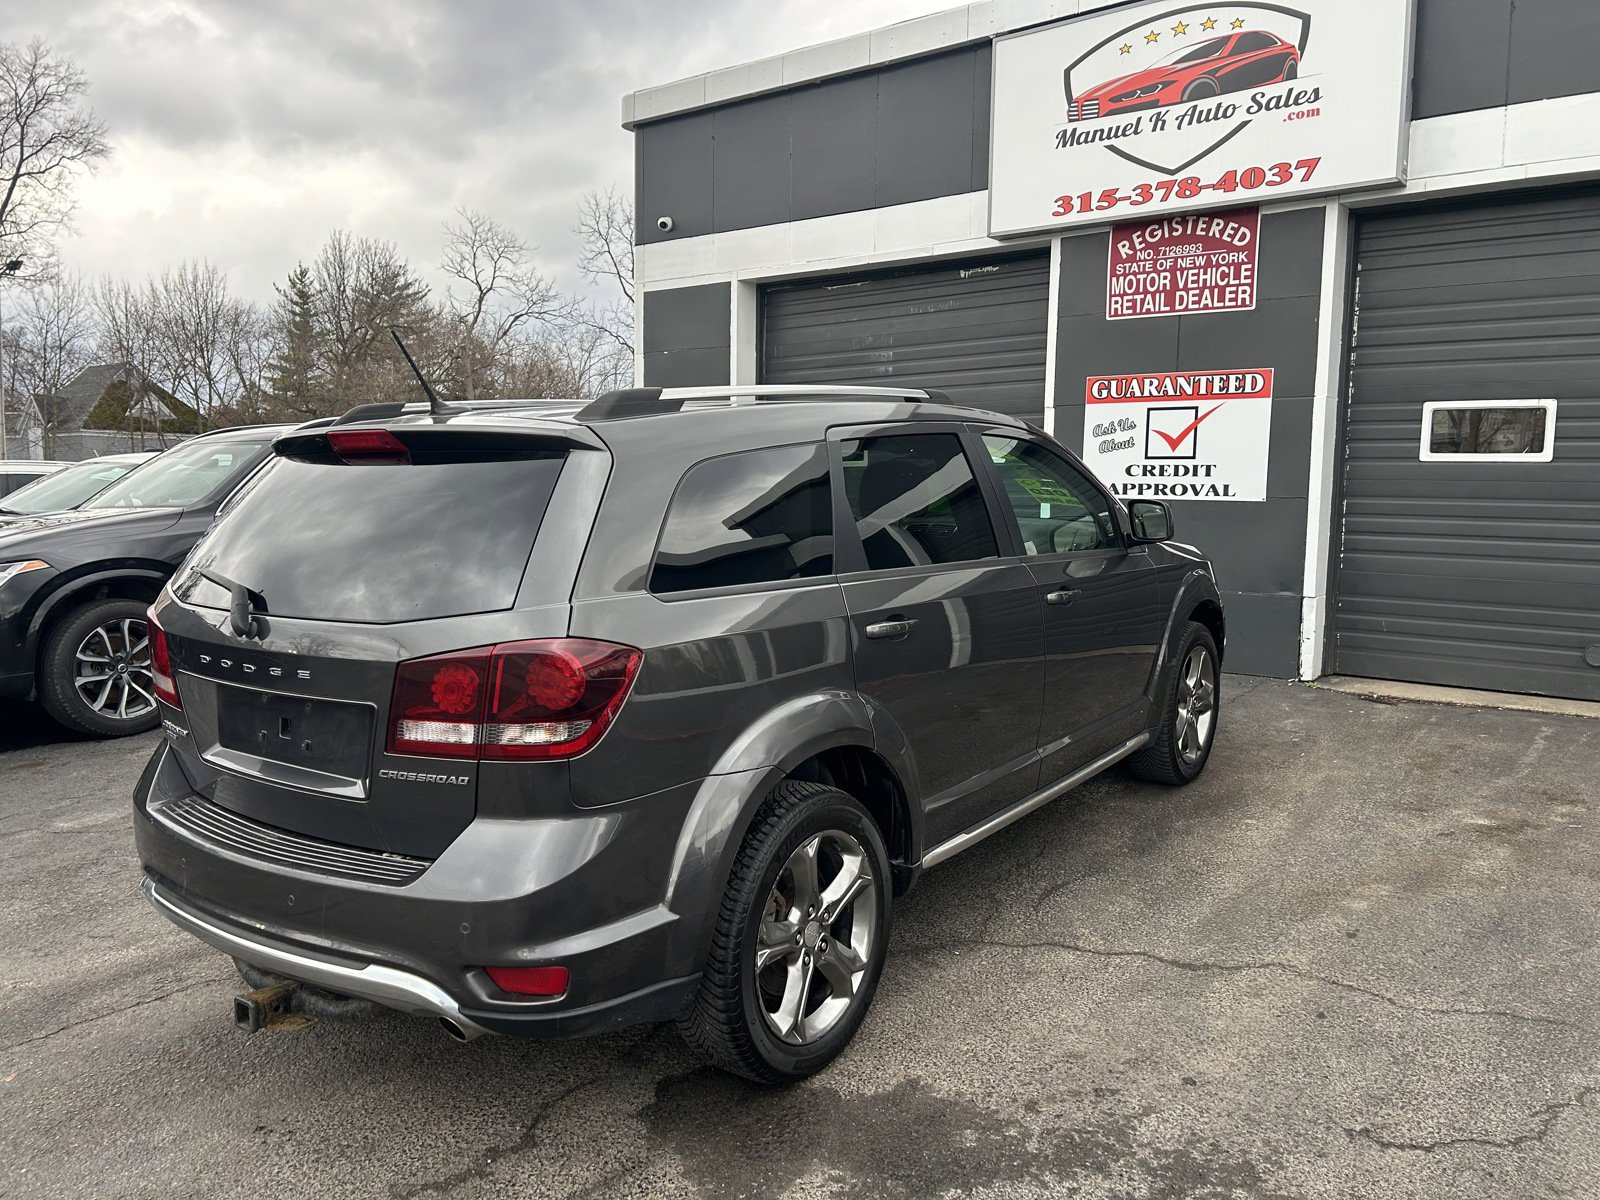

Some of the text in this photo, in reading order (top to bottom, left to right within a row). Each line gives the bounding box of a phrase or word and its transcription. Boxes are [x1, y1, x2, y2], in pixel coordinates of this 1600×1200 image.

[1055, 86, 1323, 149] Manuel K Auto Sales
[1283, 106, 1320, 122] .com
[1052, 157, 1321, 217] 315-378-4037
[1116, 216, 1251, 259] REGISTERED
[1116, 251, 1249, 274] STATE OF NEW YORK
[1136, 243, 1203, 261] NO. 7126993
[1111, 264, 1252, 295] MOTOR VEHICLE
[1111, 285, 1251, 315] RETAIL DEALER
[1090, 373, 1265, 400] GUARANTEED
[1093, 418, 1137, 437] Ask Us
[1098, 437, 1135, 454] About
[1125, 464, 1217, 477] CREDIT
[1109, 482, 1237, 497] APPROVAL
[200, 654, 311, 679] DODGE
[379, 769, 470, 785] CROSSROAD
